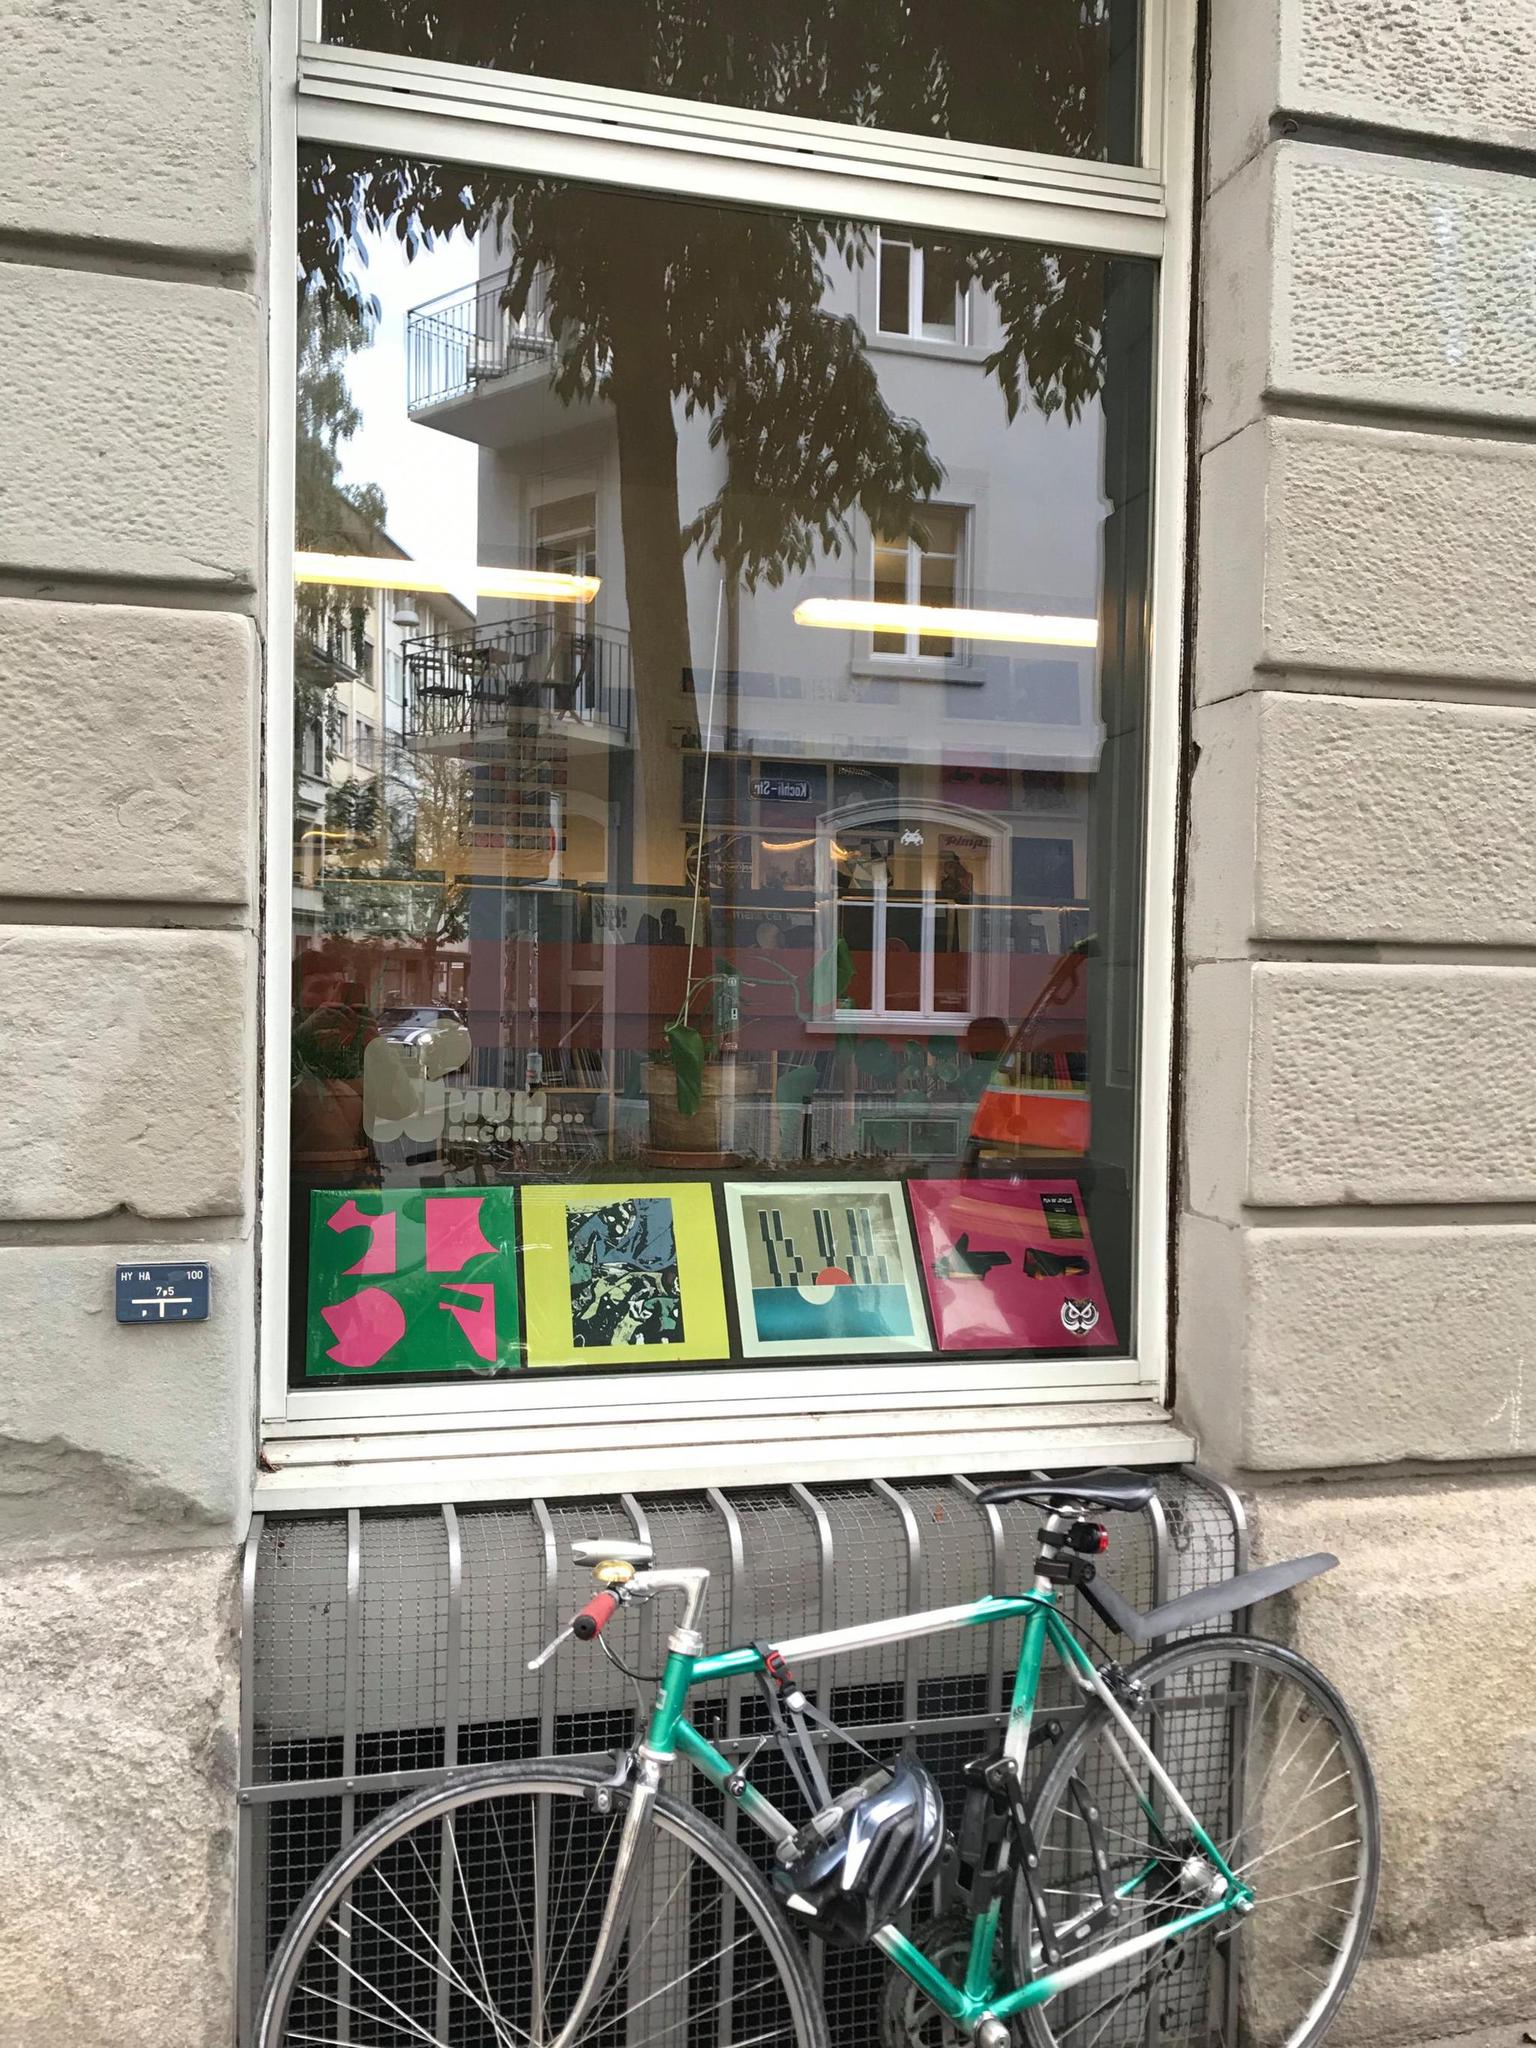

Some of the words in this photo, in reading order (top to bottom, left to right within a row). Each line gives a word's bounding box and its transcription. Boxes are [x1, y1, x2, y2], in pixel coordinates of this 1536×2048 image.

[448, 1125, 559, 1143] RECORDS
[120, 1271, 133, 1281] HY
[138, 1271, 151, 1281] HA
[186, 1270, 204, 1280] 100
